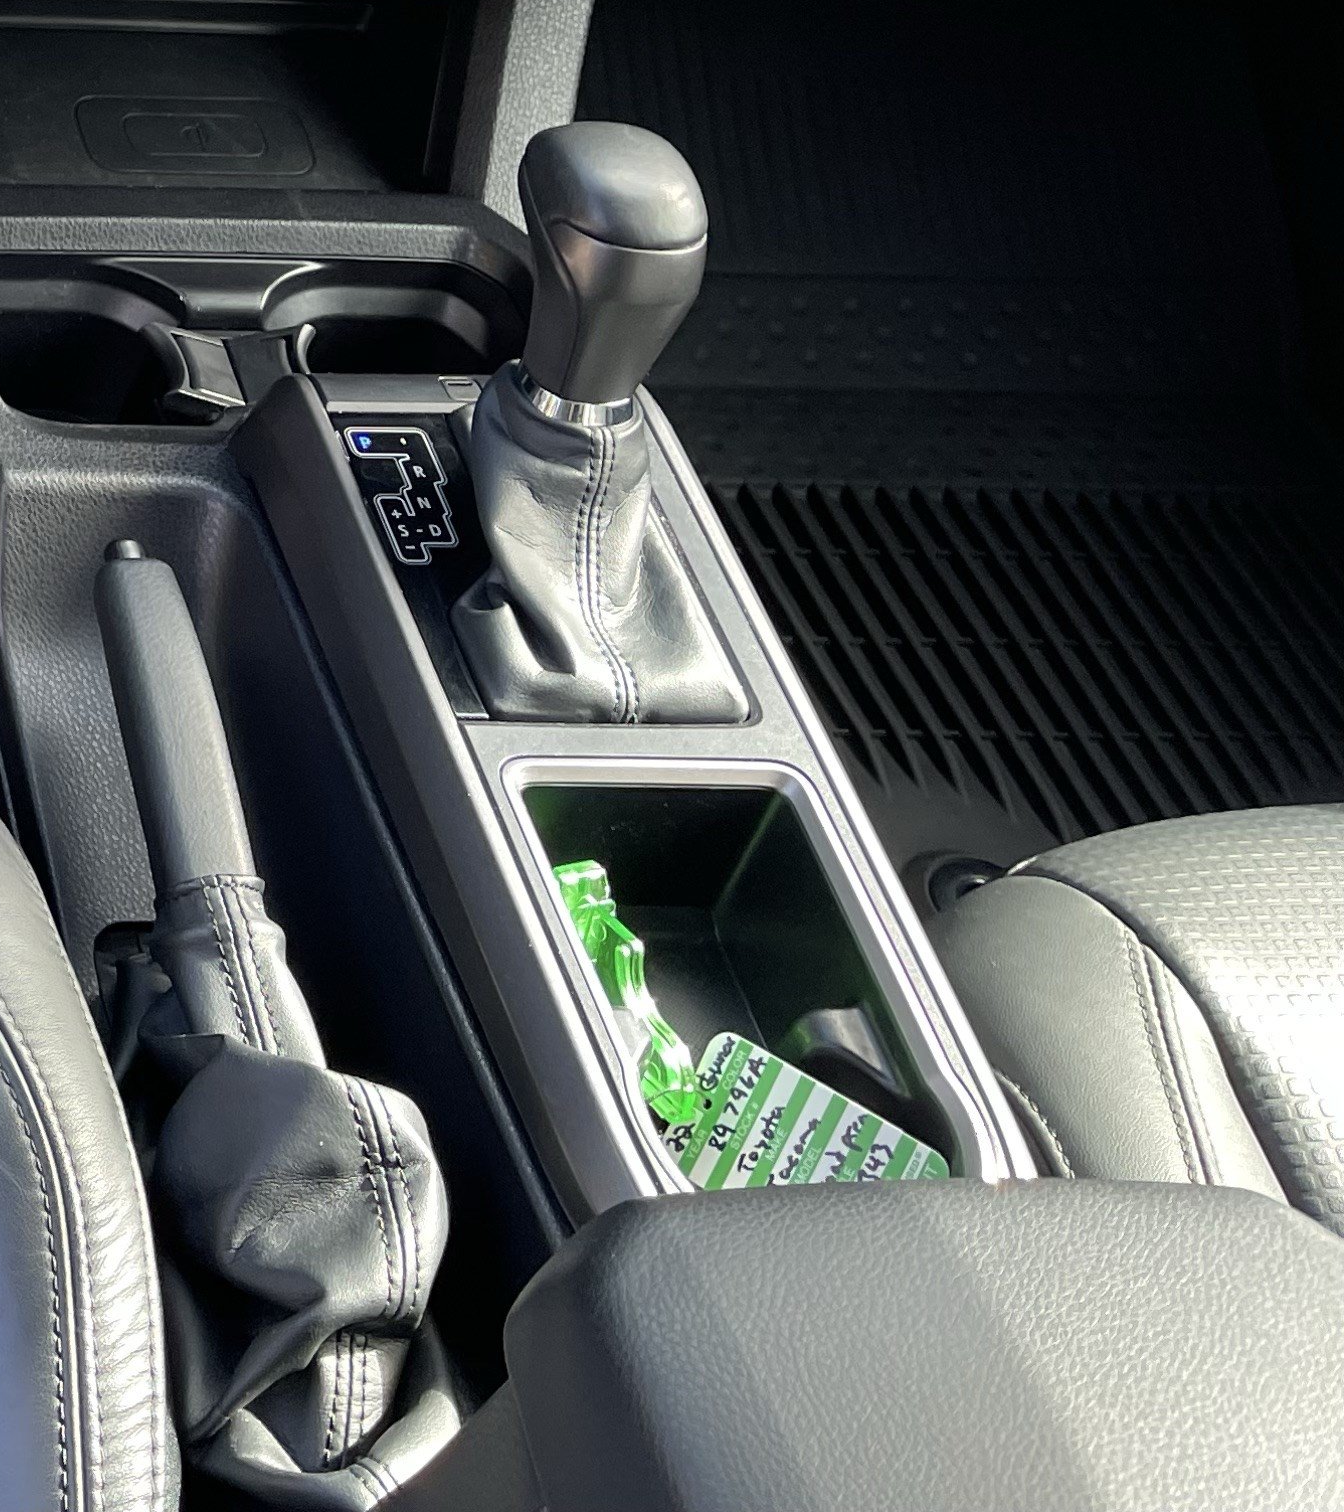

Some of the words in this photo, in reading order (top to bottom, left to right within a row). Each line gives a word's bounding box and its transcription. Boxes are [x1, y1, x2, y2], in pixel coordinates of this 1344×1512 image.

[412, 466, 426, 478] R
[417, 497, 432, 509] N
[398, 524, 410, 537] S
[429, 524, 442, 536] D
[721, 1050, 747, 1090] COLOR
[686, 1129, 707, 1159] YEAR
[730, 1112, 755, 1150] STOCK
[737, 1106, 786, 1173] Toyota
[764, 1128, 788, 1162] MAKE
